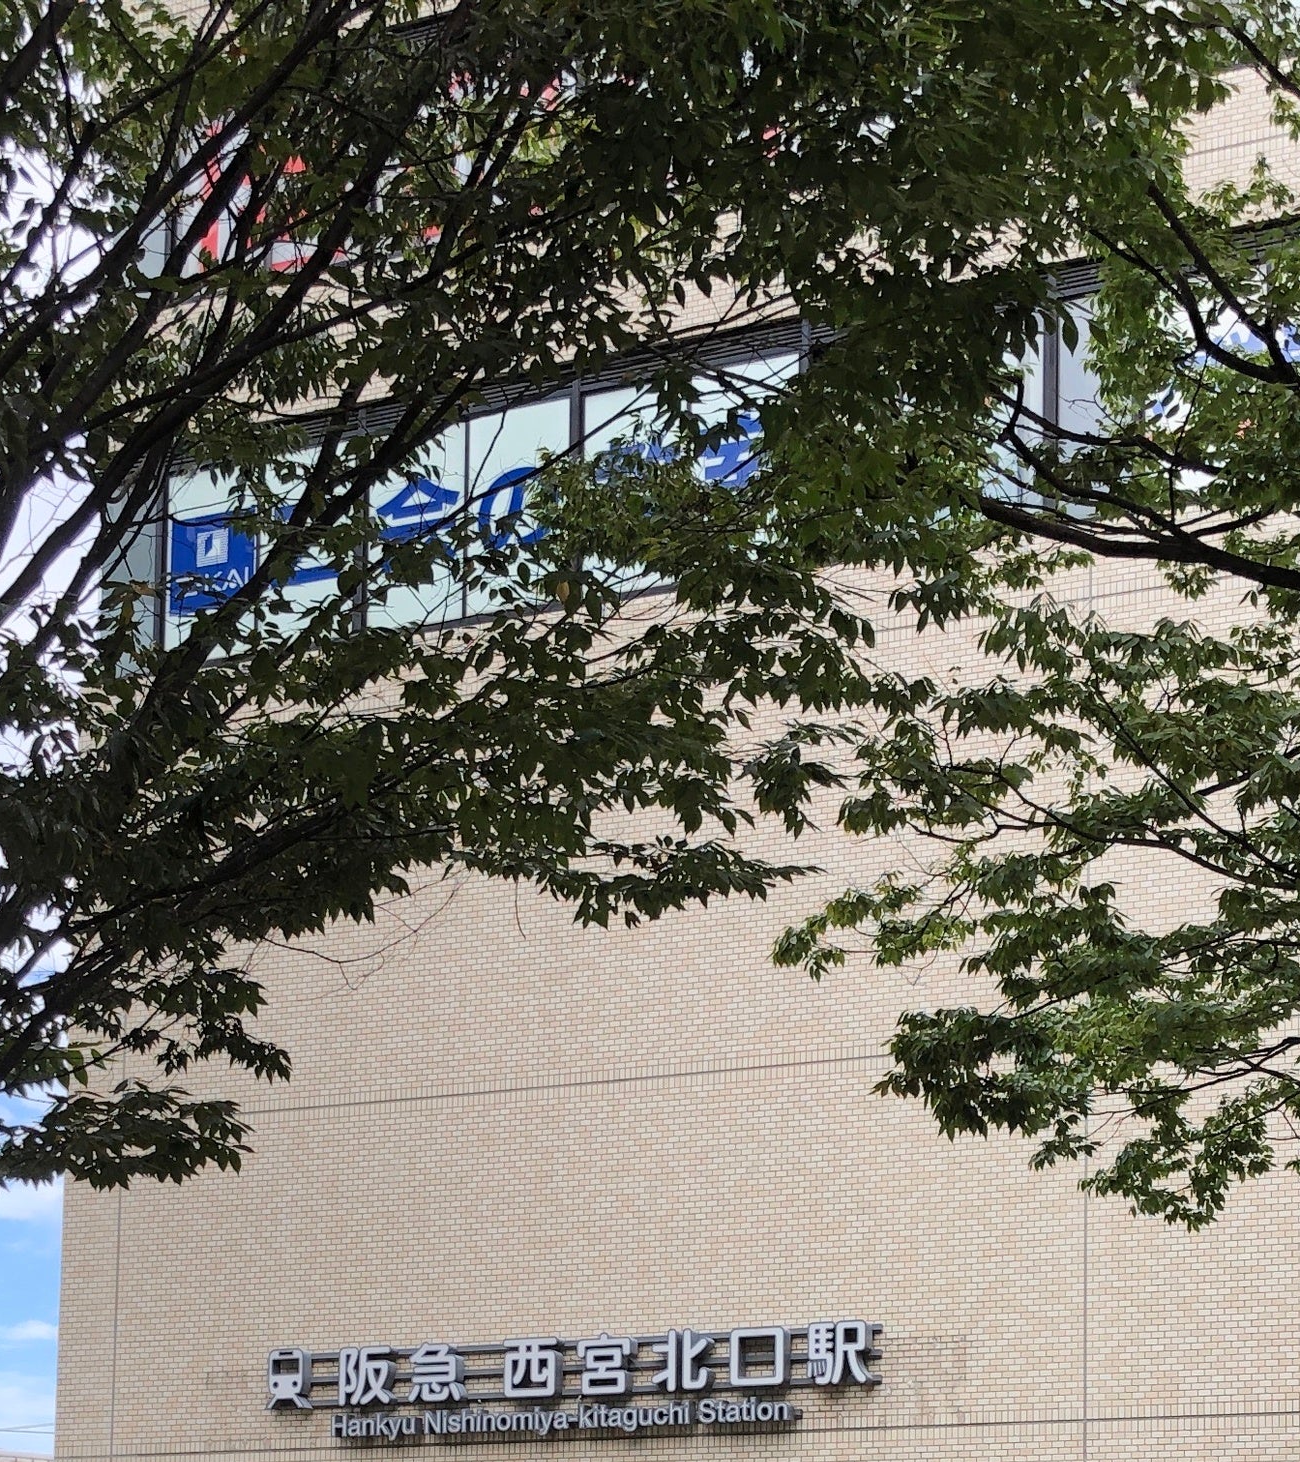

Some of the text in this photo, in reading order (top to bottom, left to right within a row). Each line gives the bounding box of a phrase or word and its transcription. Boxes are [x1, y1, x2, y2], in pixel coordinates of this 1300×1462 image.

[338, 1319, 868, 1406] 阪急 西宮北口駅
[330, 1398, 790, 1441] Hankyu Nishinomiya-kitaguchi Station
